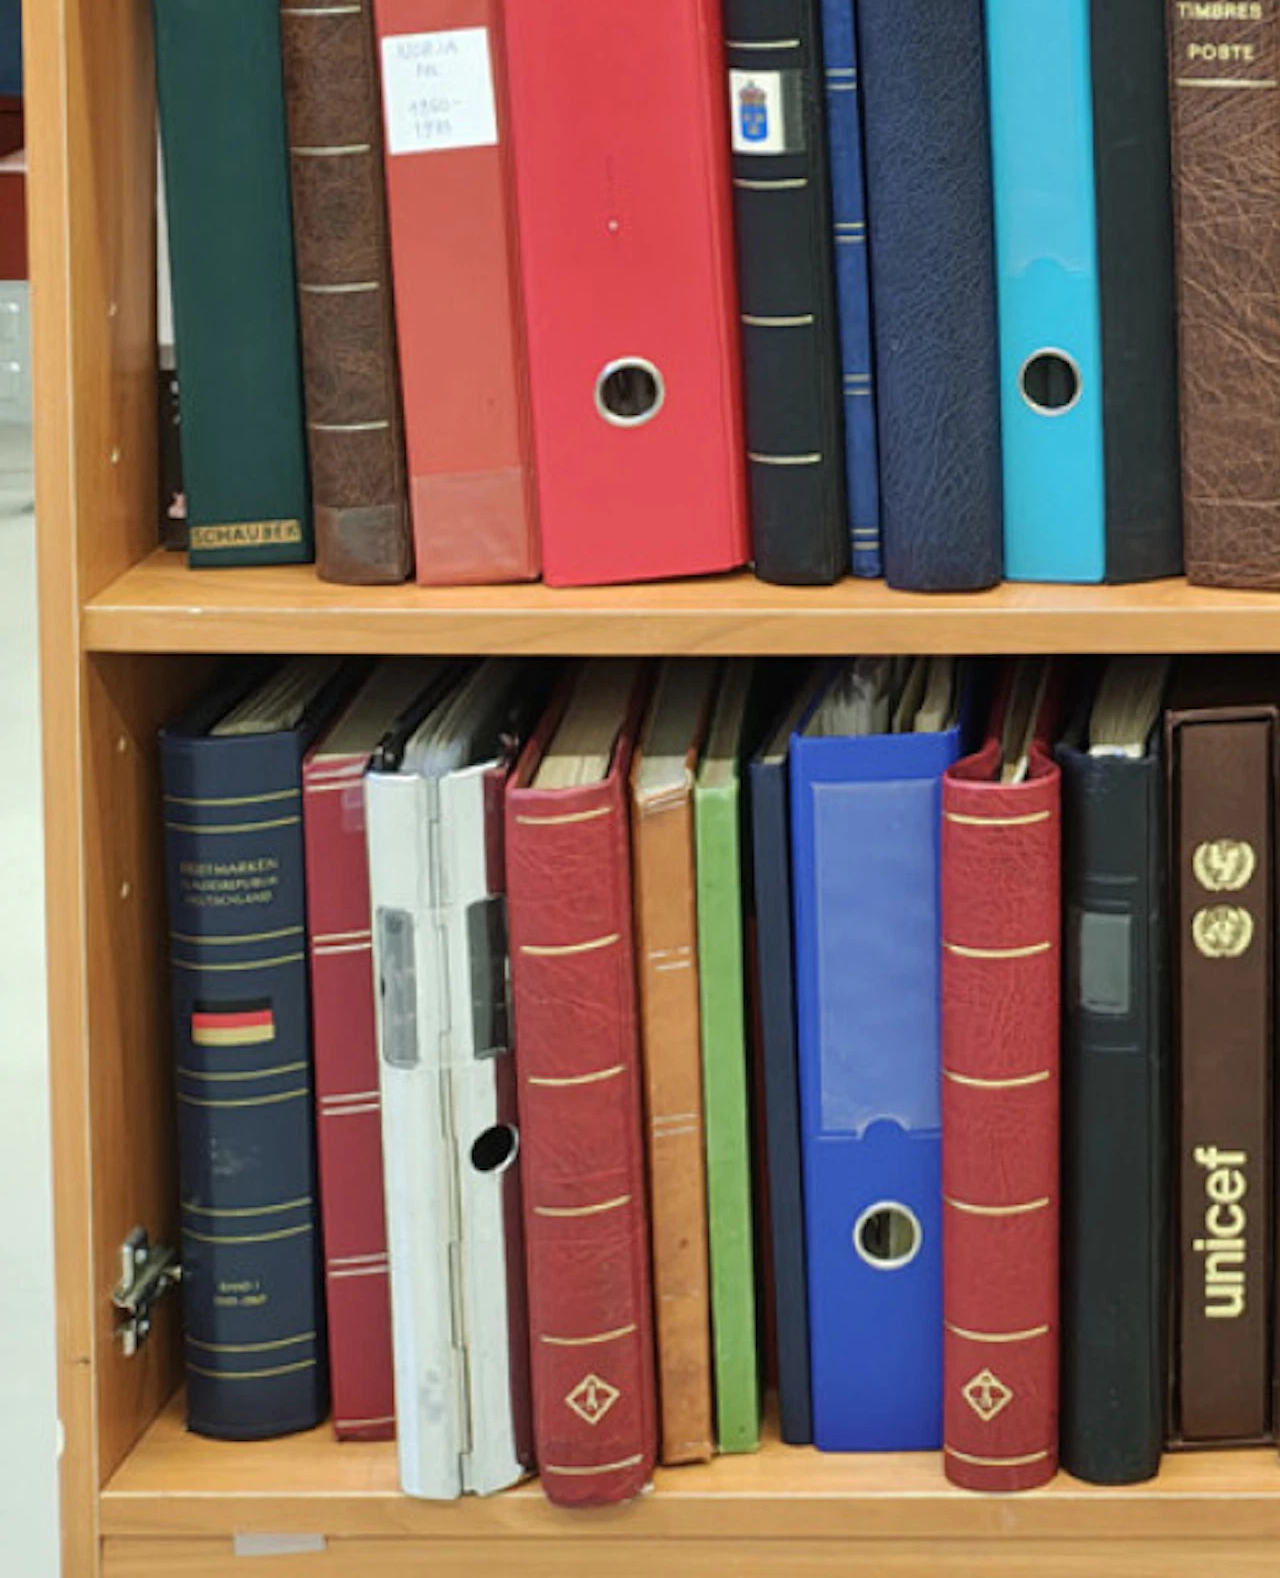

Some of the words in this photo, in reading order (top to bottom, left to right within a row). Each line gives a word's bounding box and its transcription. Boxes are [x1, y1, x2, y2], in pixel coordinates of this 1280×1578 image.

[1176, 1, 1262, 22] TIMBRES
[1187, 42, 1256, 62] POSTE
[1194, 1146, 1247, 1318] unicef
